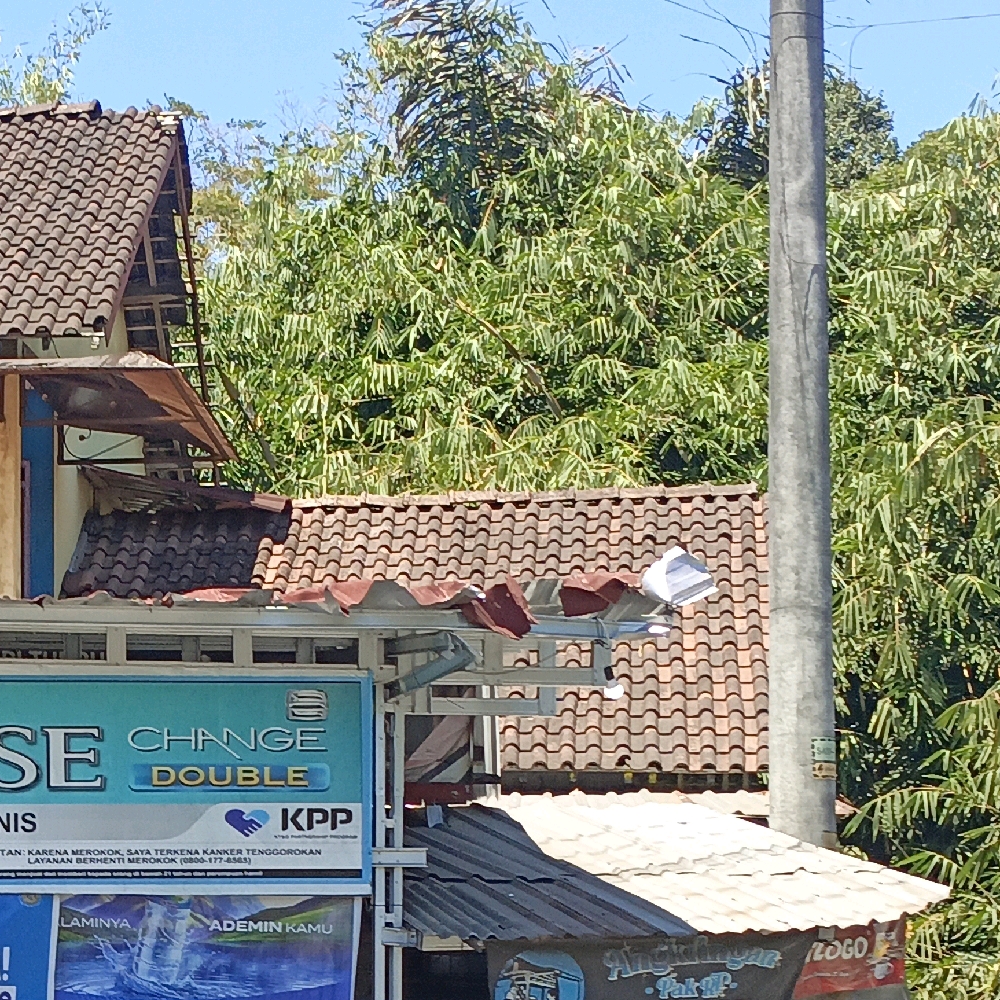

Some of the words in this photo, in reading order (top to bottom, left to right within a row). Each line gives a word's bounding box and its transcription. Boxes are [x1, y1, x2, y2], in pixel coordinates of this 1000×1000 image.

[128, 726, 328, 760] CHANGE
[151, 766, 309, 787] DOUBLE
[281, 807, 353, 831] KPP
[127, 857, 178, 865] MEROKOK
[245, 849, 322, 857] TENGGOROKAN
[209, 919, 283, 933] ADEMIN
[285, 923, 334, 935] KAMU
